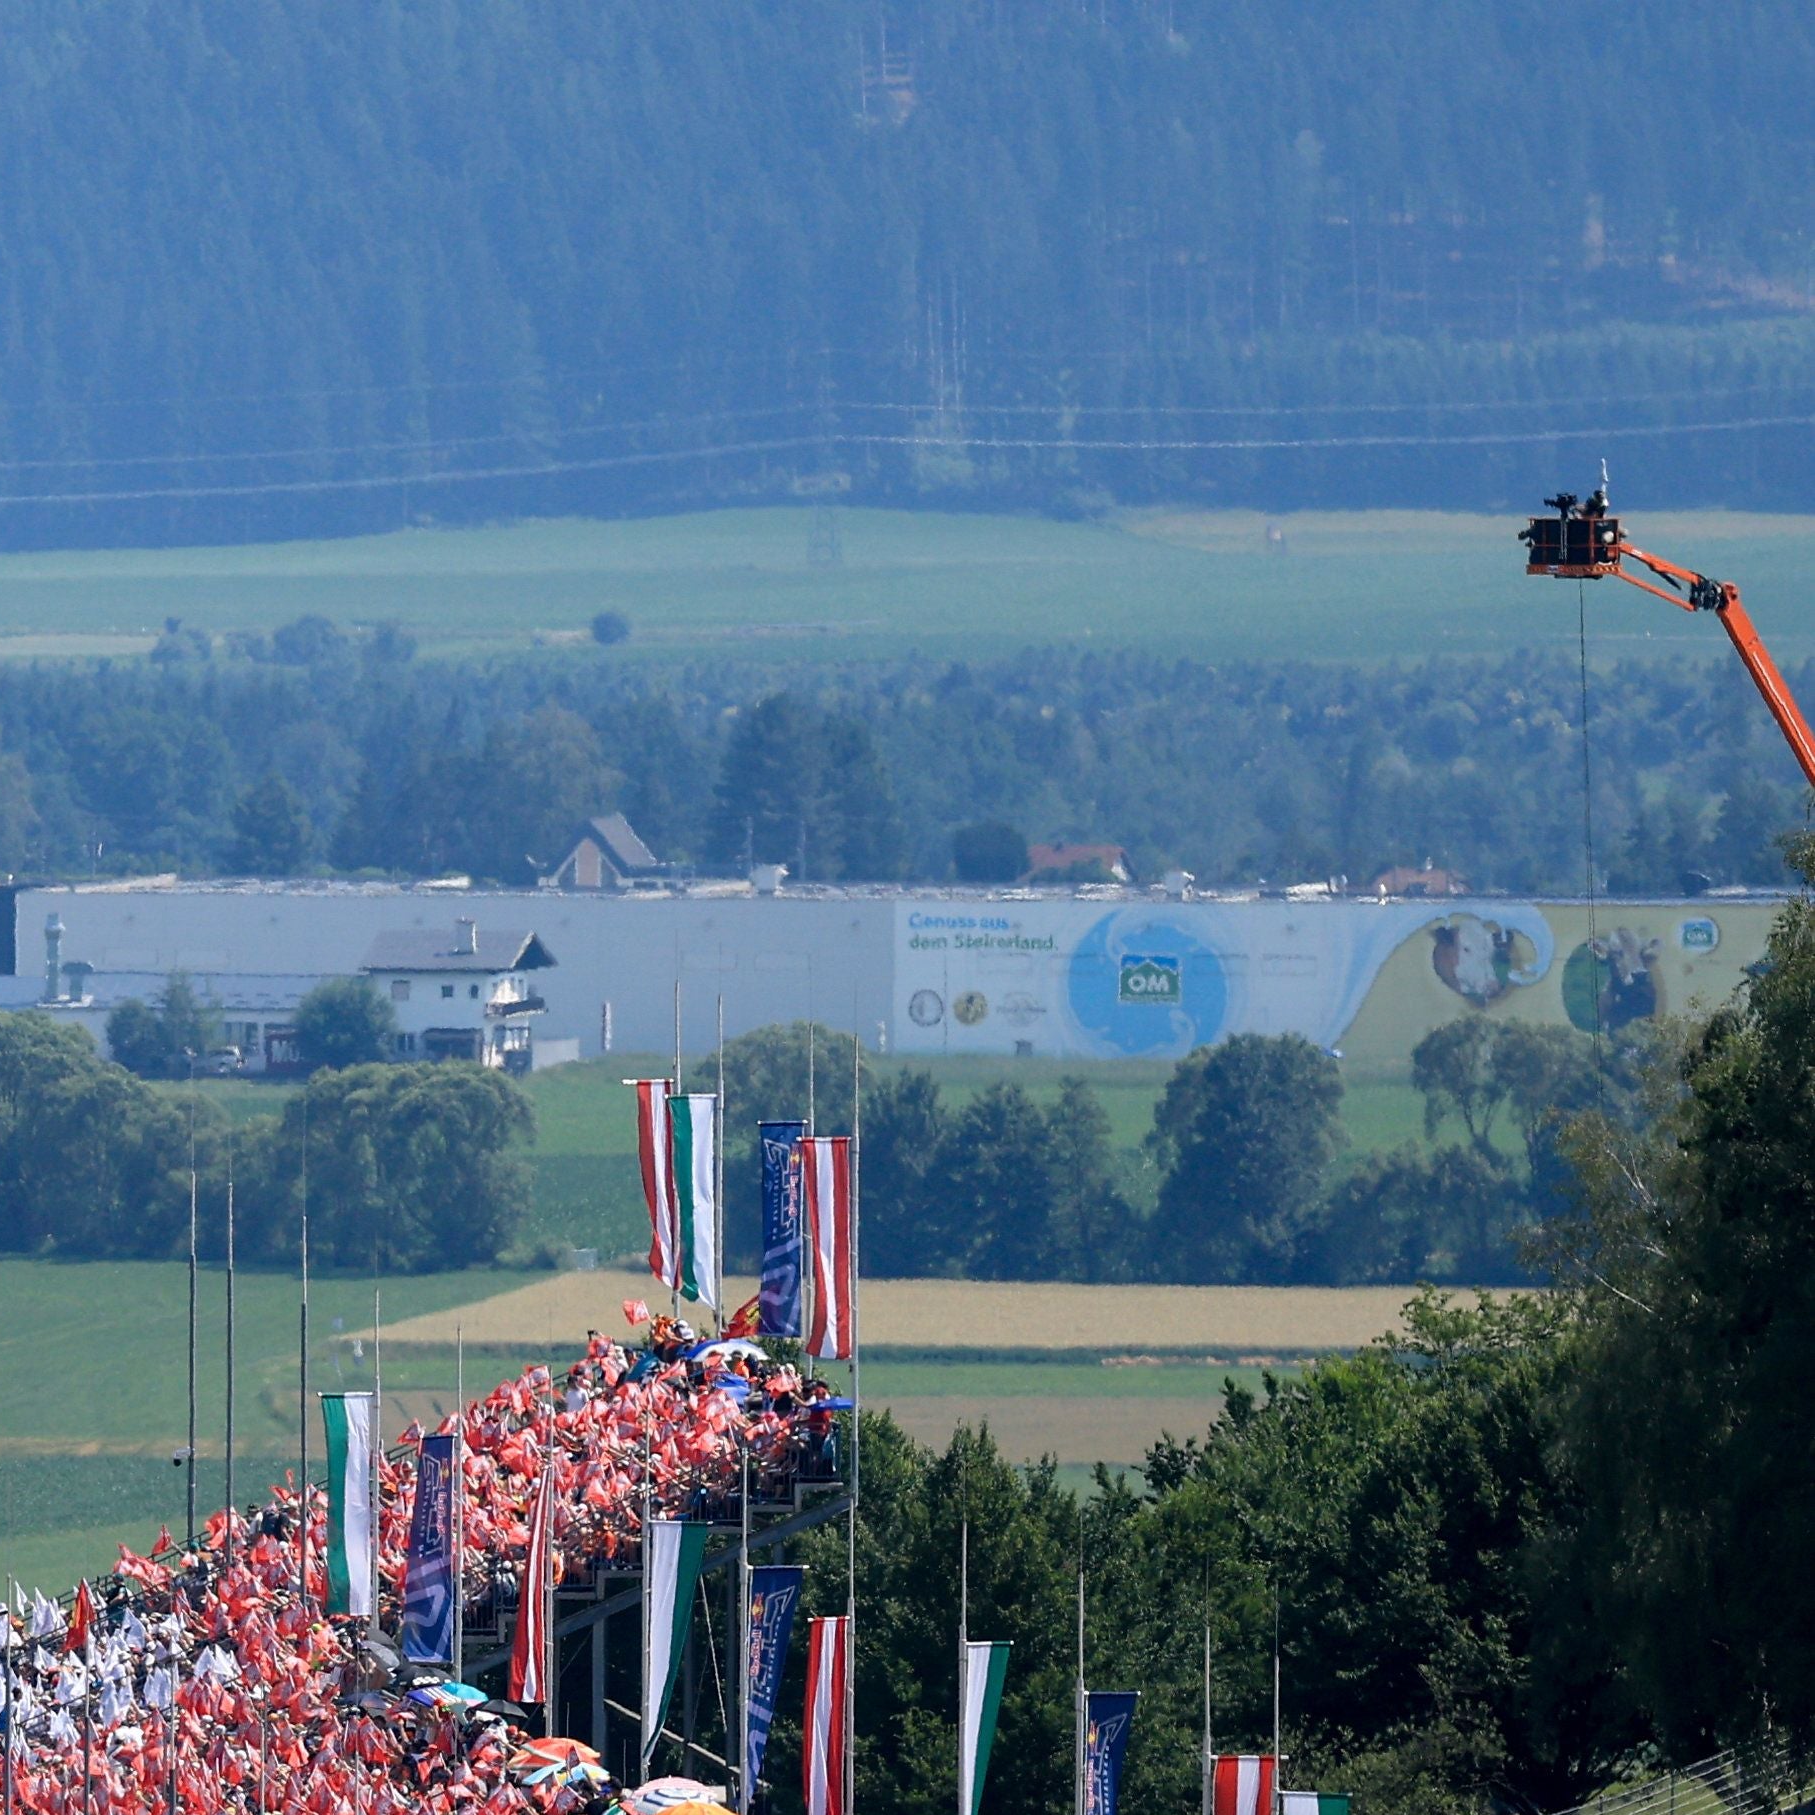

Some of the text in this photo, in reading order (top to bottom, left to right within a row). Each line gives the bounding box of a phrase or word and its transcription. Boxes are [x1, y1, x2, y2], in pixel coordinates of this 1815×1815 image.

[979, 916, 1009, 930] aus
[908, 933, 947, 949] dem
[1128, 974, 1169, 993] OM
